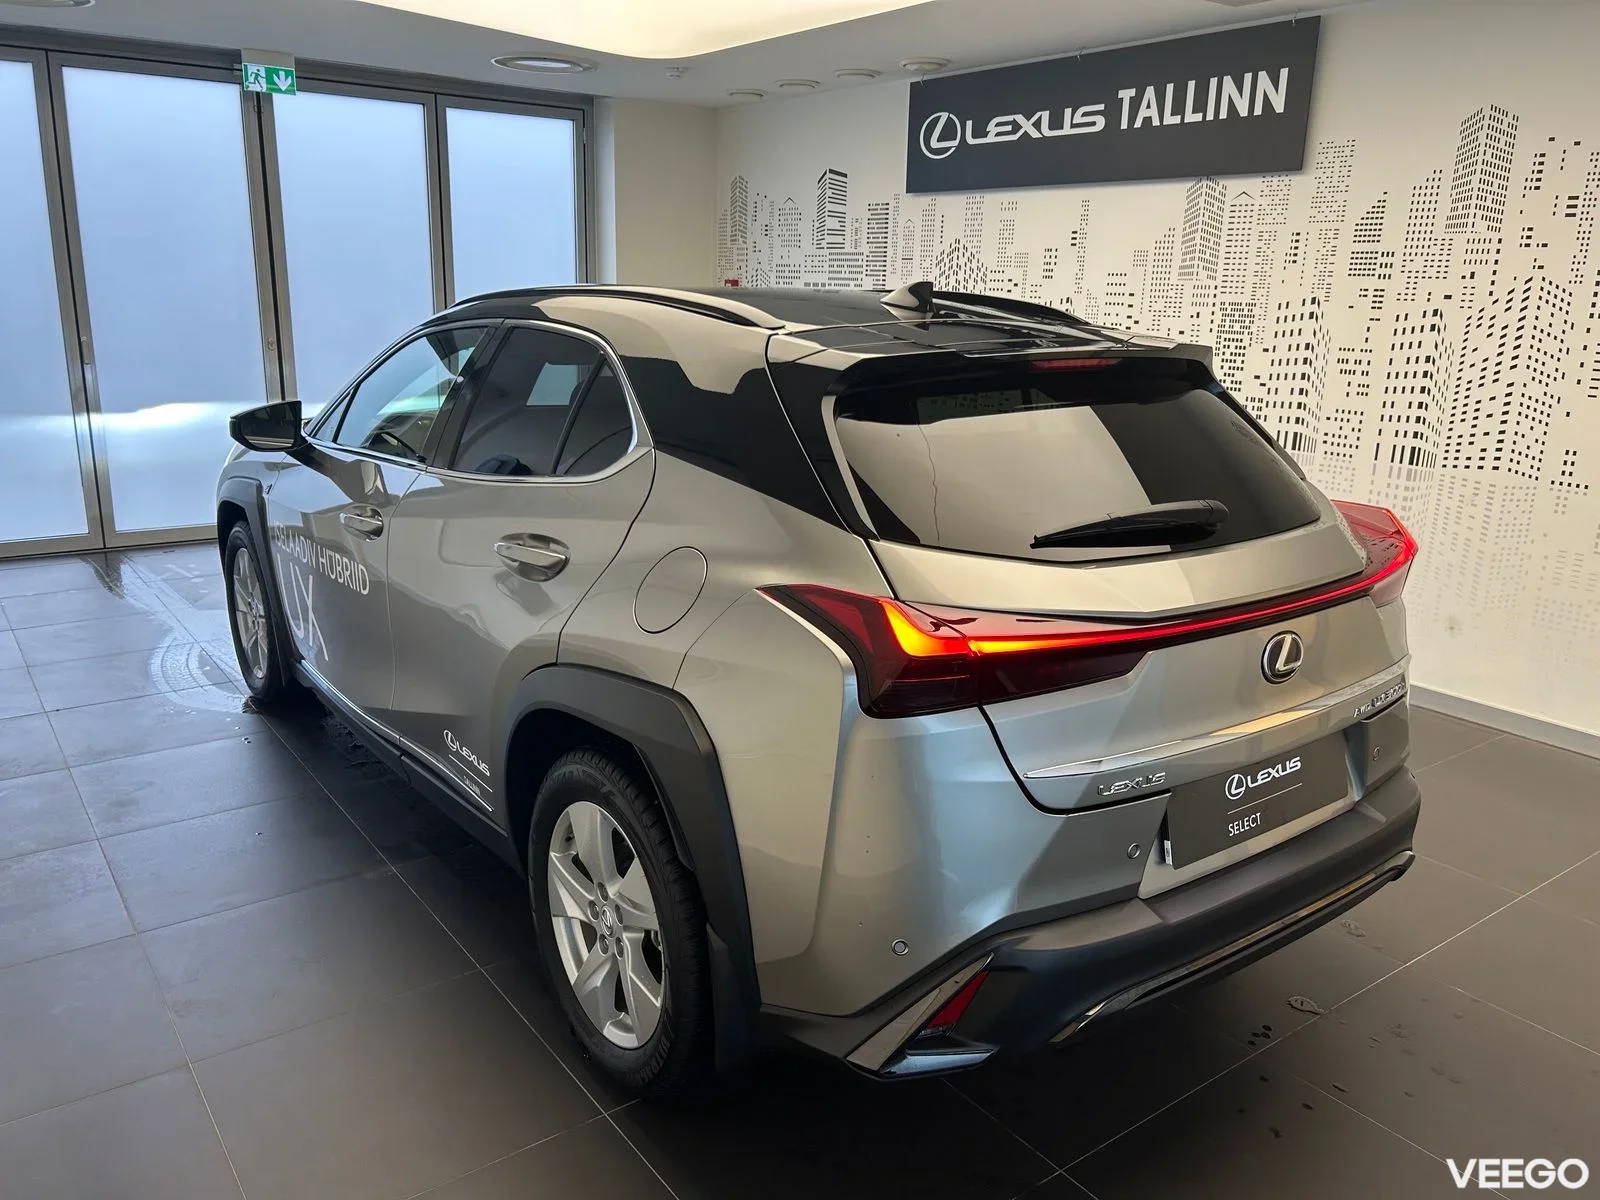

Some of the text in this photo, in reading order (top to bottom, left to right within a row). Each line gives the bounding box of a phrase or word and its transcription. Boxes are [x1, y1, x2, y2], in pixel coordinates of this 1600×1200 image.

[966, 67, 1289, 145] LEXUS TALLINN
[276, 553, 329, 662] UX
[456, 741, 491, 777] LEXUS
[1246, 756, 1302, 788] LEXUS
[1097, 771, 1167, 796] LEXUS
[1228, 812, 1262, 837] SELECT
